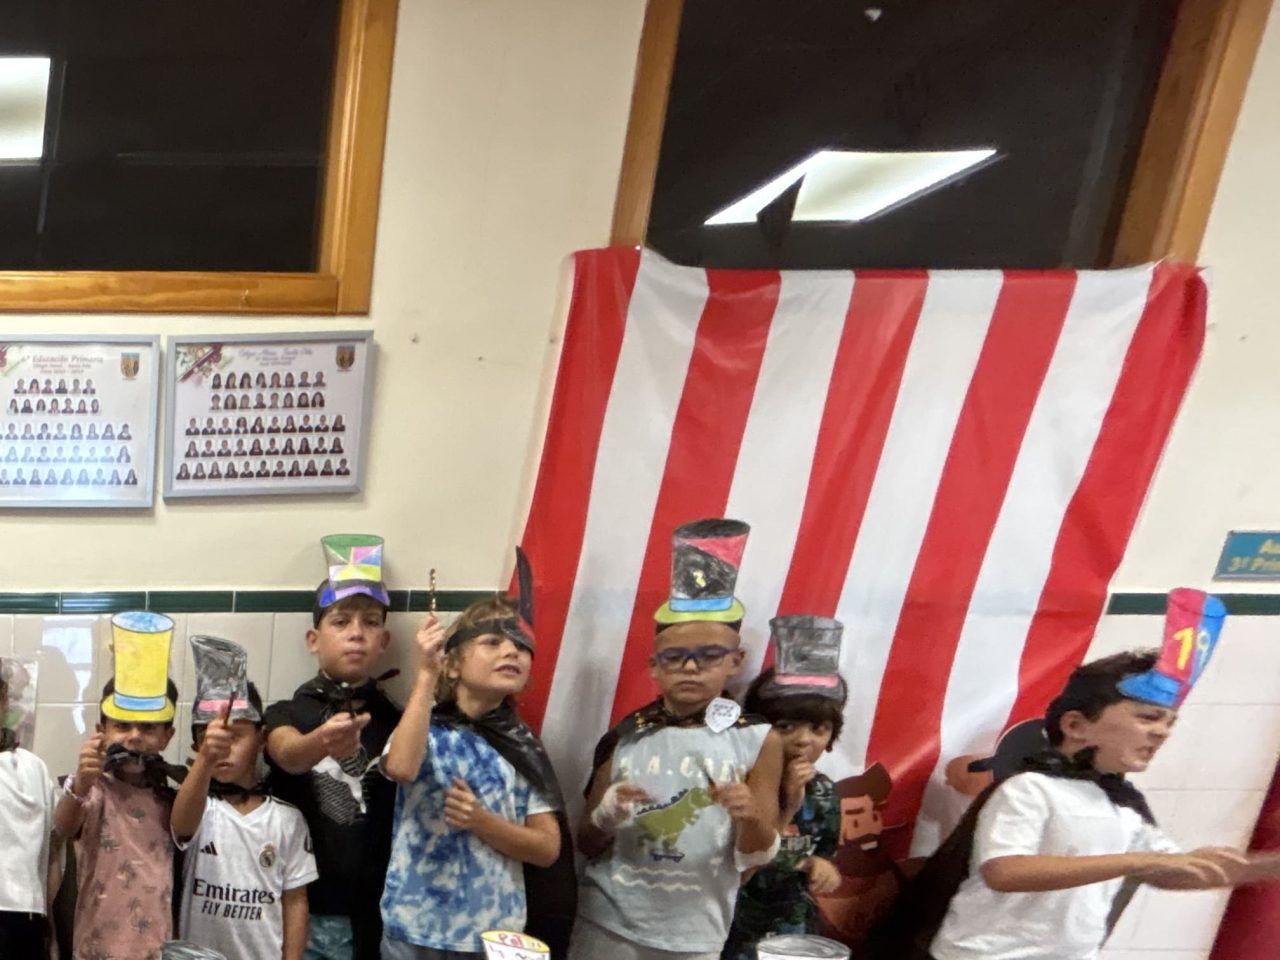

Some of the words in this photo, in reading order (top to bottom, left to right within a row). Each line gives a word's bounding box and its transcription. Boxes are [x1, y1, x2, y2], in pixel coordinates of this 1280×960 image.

[192, 878, 276, 905] Emirates
[201, 899, 221, 916] FLY
[223, 904, 263, 921] BETTER
